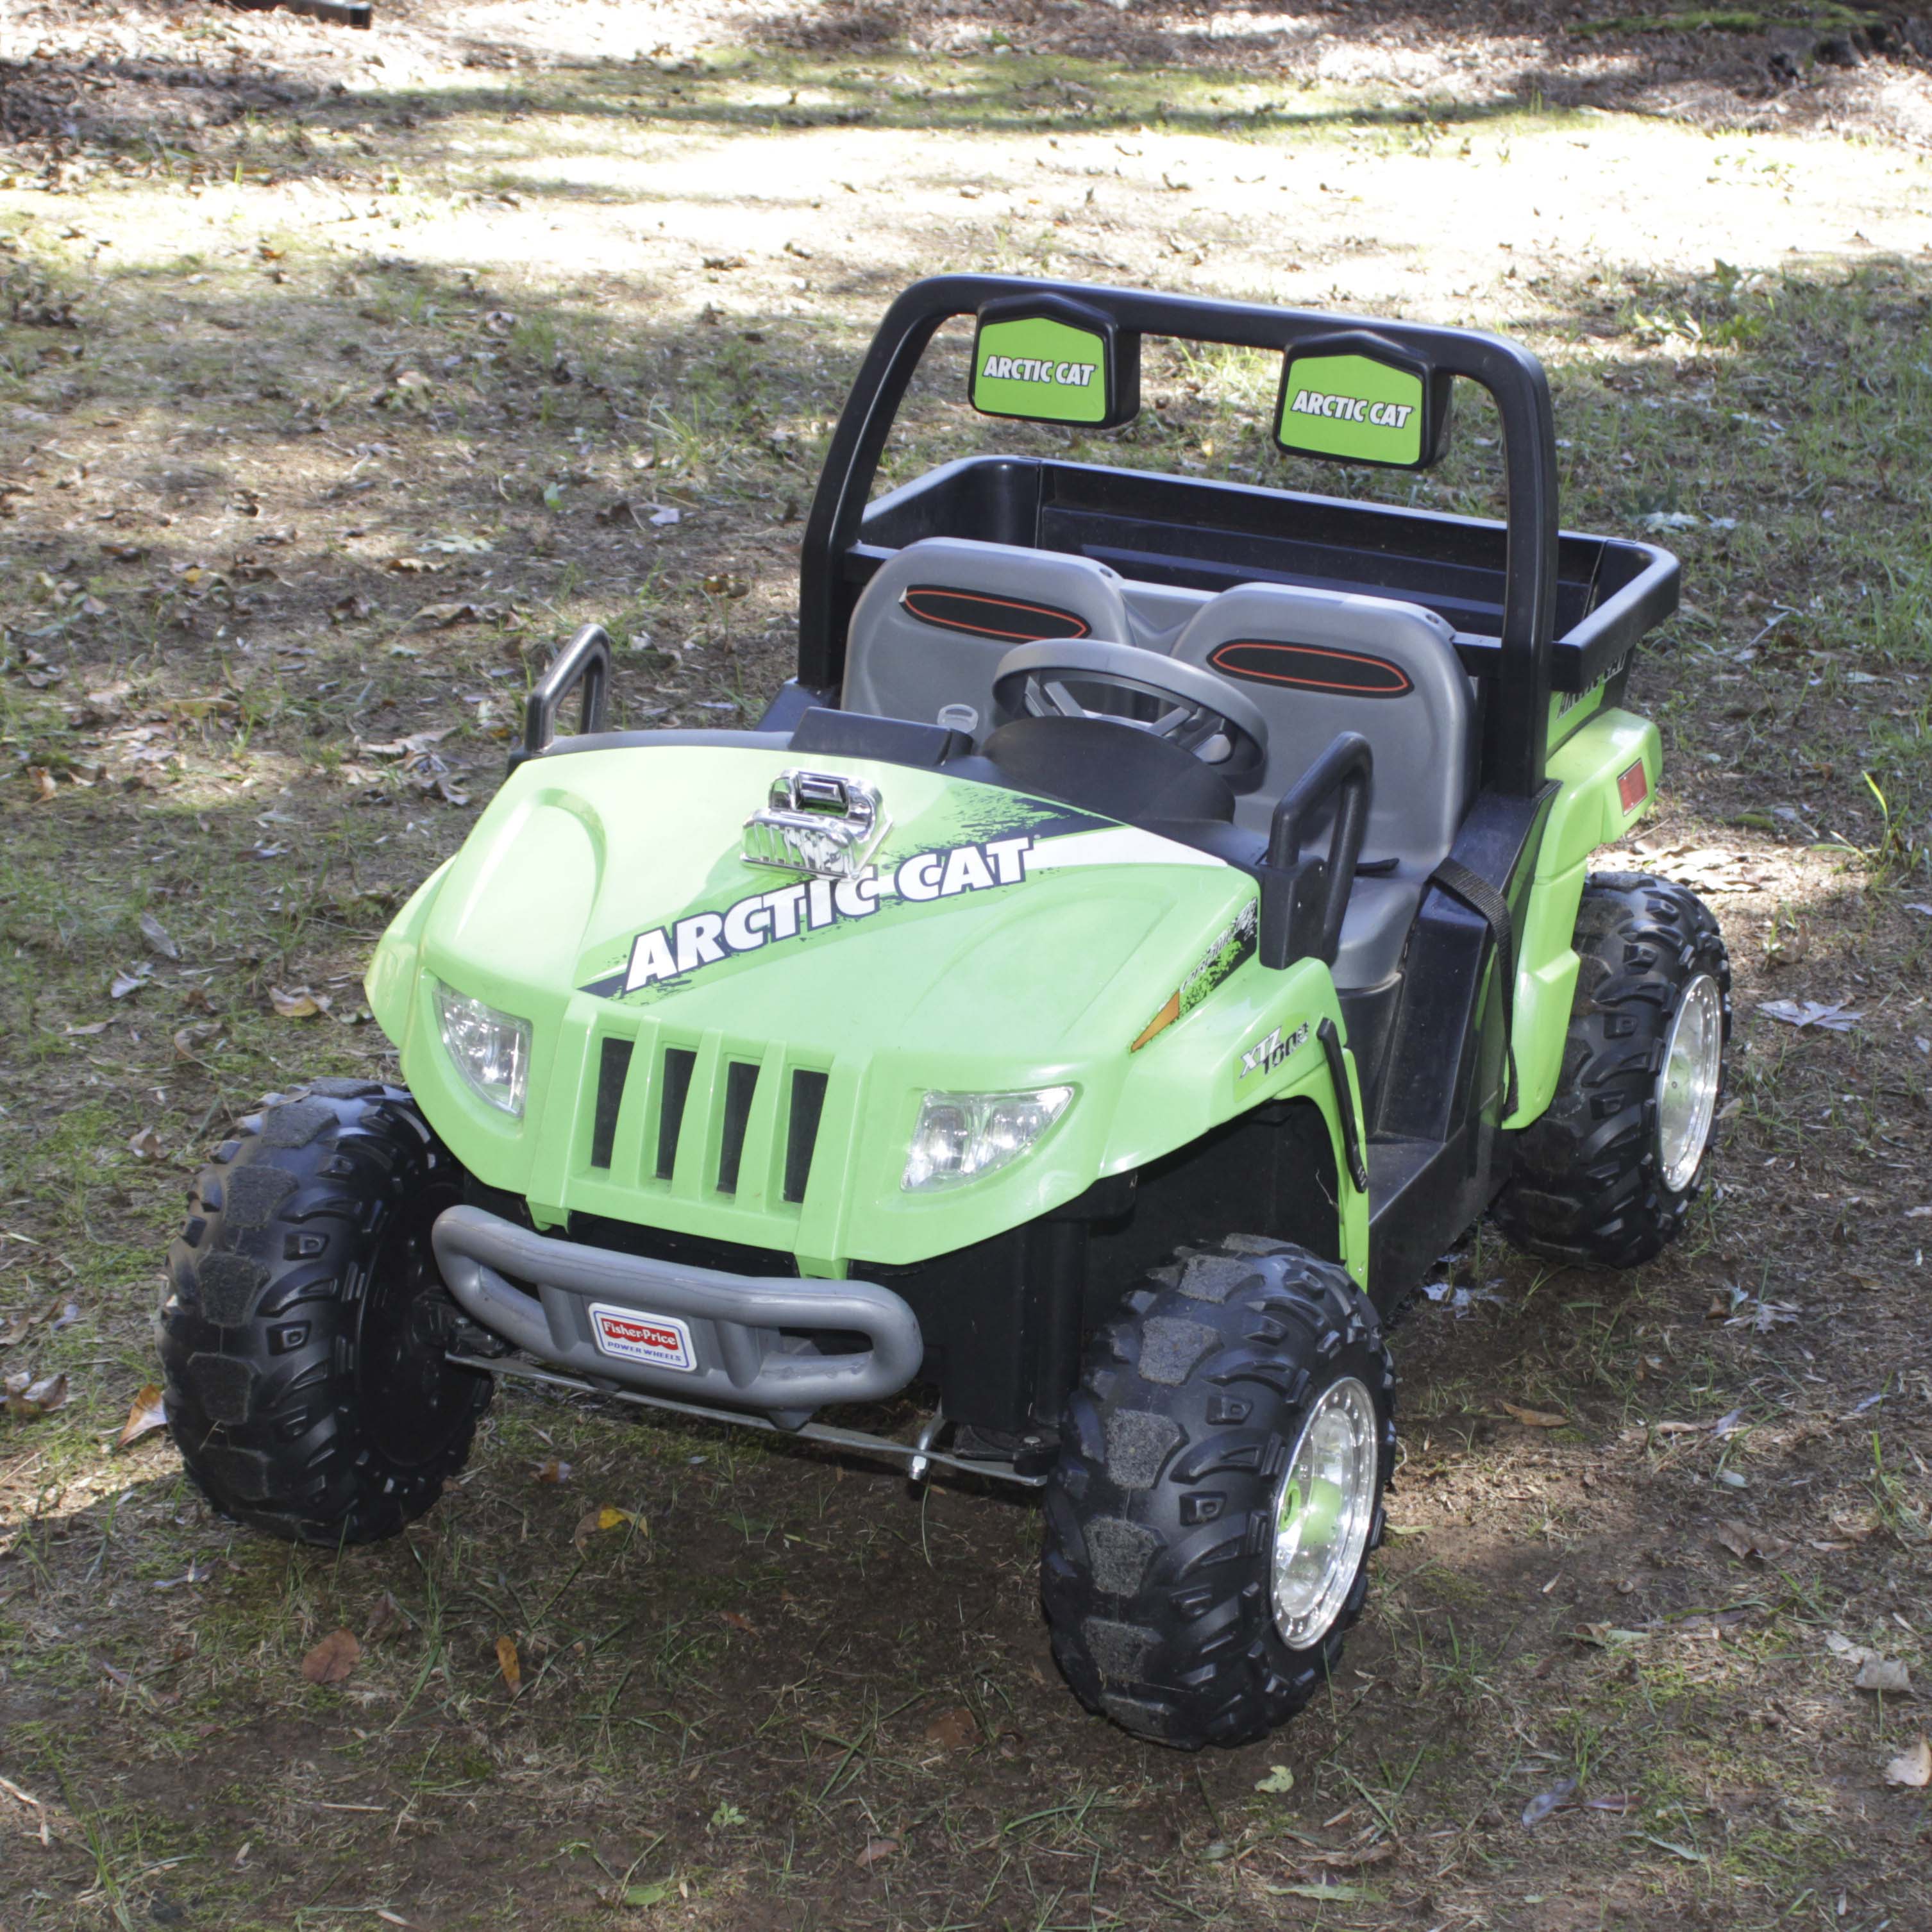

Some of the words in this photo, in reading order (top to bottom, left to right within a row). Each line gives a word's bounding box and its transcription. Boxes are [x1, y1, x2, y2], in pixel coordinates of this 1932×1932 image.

[982, 355, 1054, 383] ARCTIC
[1055, 362, 1096, 387] CAT
[1290, 389, 1368, 423] ARCTIC
[1369, 401, 1414, 429] CAT
[624, 864, 878, 993] ARCTIC
[895, 836, 1033, 902] CAT
[1239, 1025, 1282, 1079] XTZ
[603, 1321, 677, 1345] Fisher-Price
[607, 1341, 641, 1354] POWER
[644, 1349, 682, 1361] WHEELS
